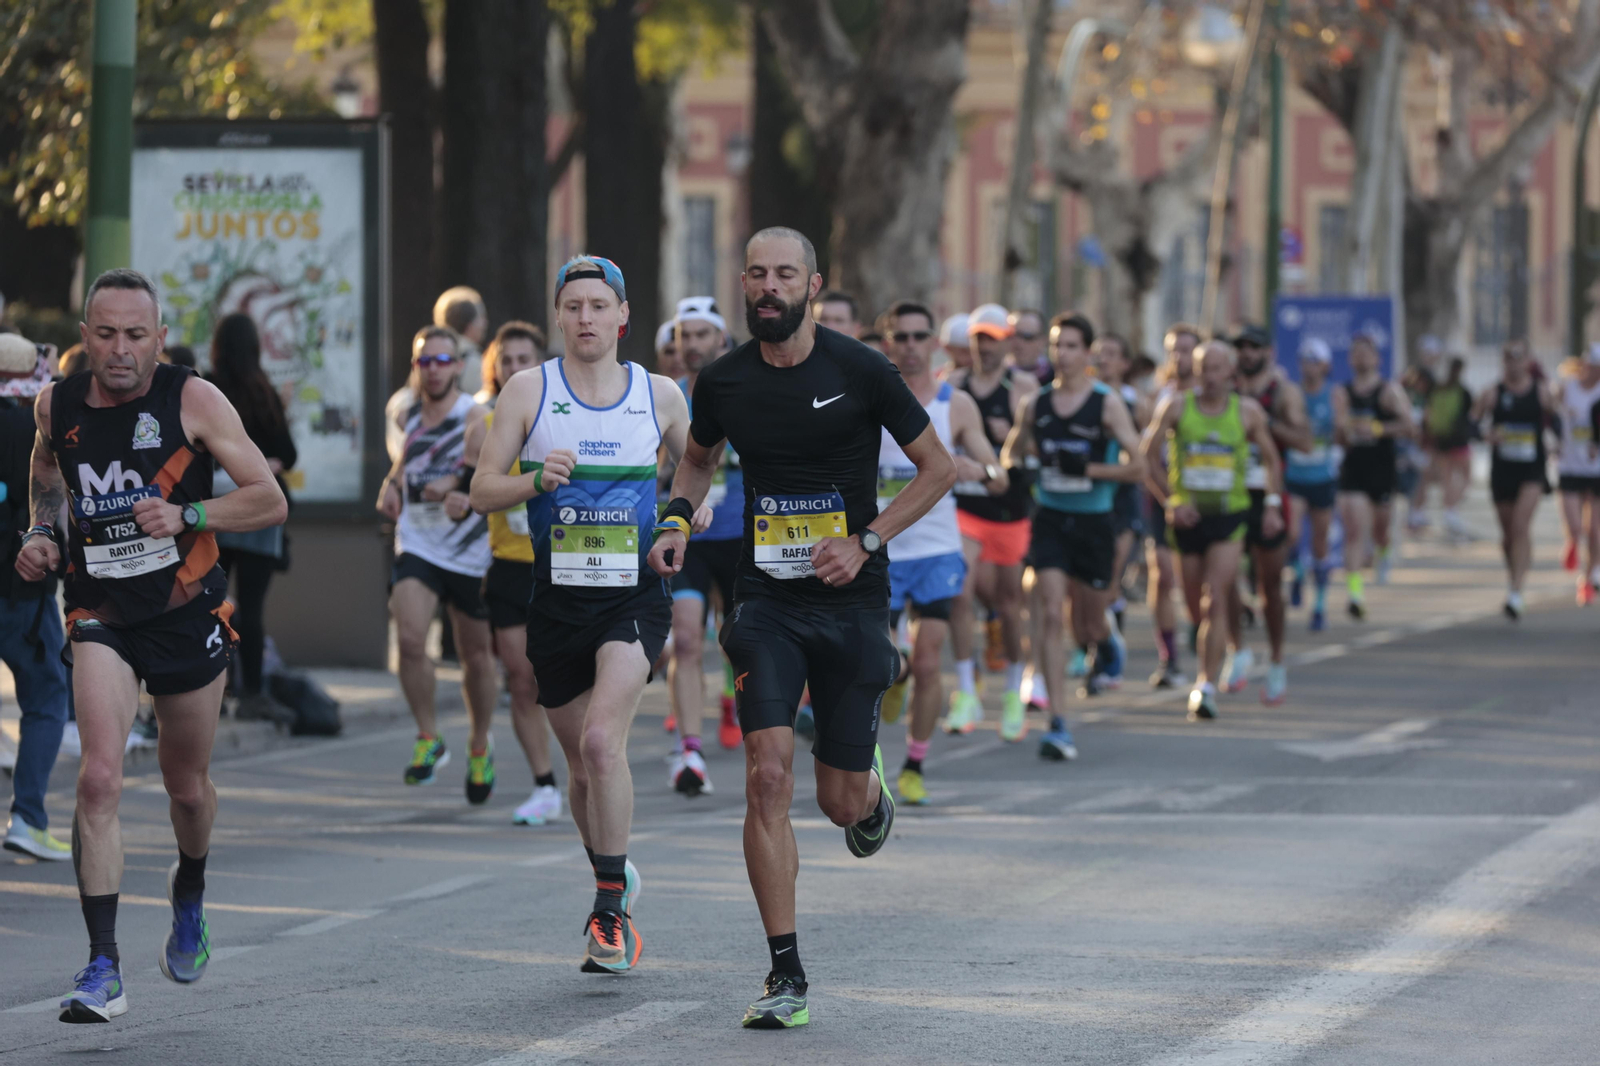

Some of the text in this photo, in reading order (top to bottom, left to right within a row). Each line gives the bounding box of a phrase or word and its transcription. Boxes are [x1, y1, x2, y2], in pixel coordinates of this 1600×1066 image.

[175, 211, 321, 239] JUNTOS
[579, 440, 621, 451] clapham
[579, 448, 616, 457] chasers
[97, 491, 149, 512] ZURICH
[779, 499, 832, 511] ZURICH
[579, 510, 628, 522] ZURICH
[105, 521, 138, 539] 1752
[787, 525, 809, 539] 611
[584, 535, 605, 548] 896
[108, 542, 145, 558] RAYITO
[586, 556, 602, 566] ALI
